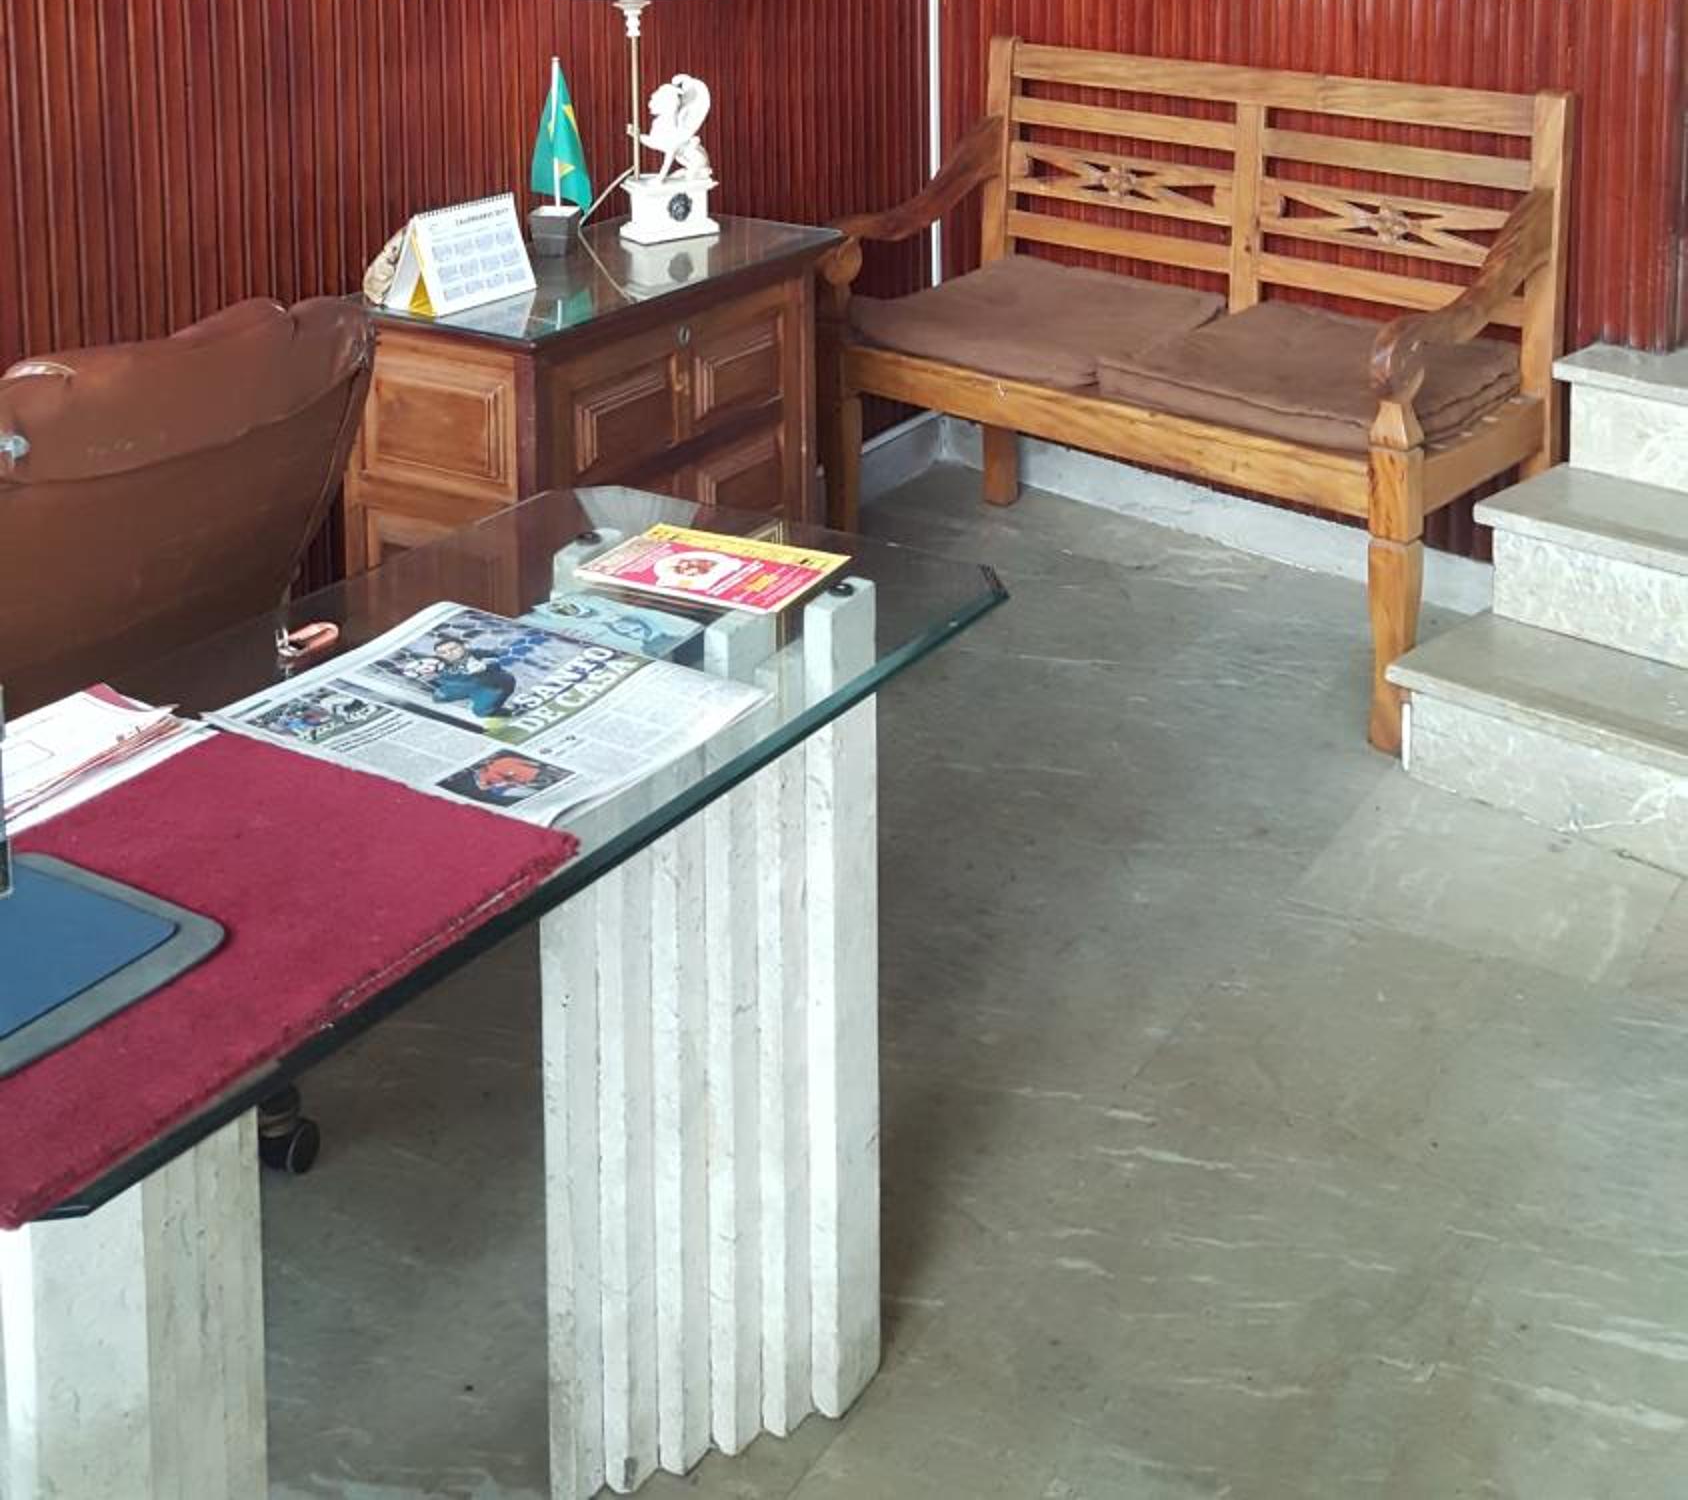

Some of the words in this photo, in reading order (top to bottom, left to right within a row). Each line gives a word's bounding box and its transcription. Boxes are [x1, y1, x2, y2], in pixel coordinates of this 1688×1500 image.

[508, 705, 567, 734] DE
[554, 659, 640, 708] CASA
[511, 646, 616, 709] SANTO
